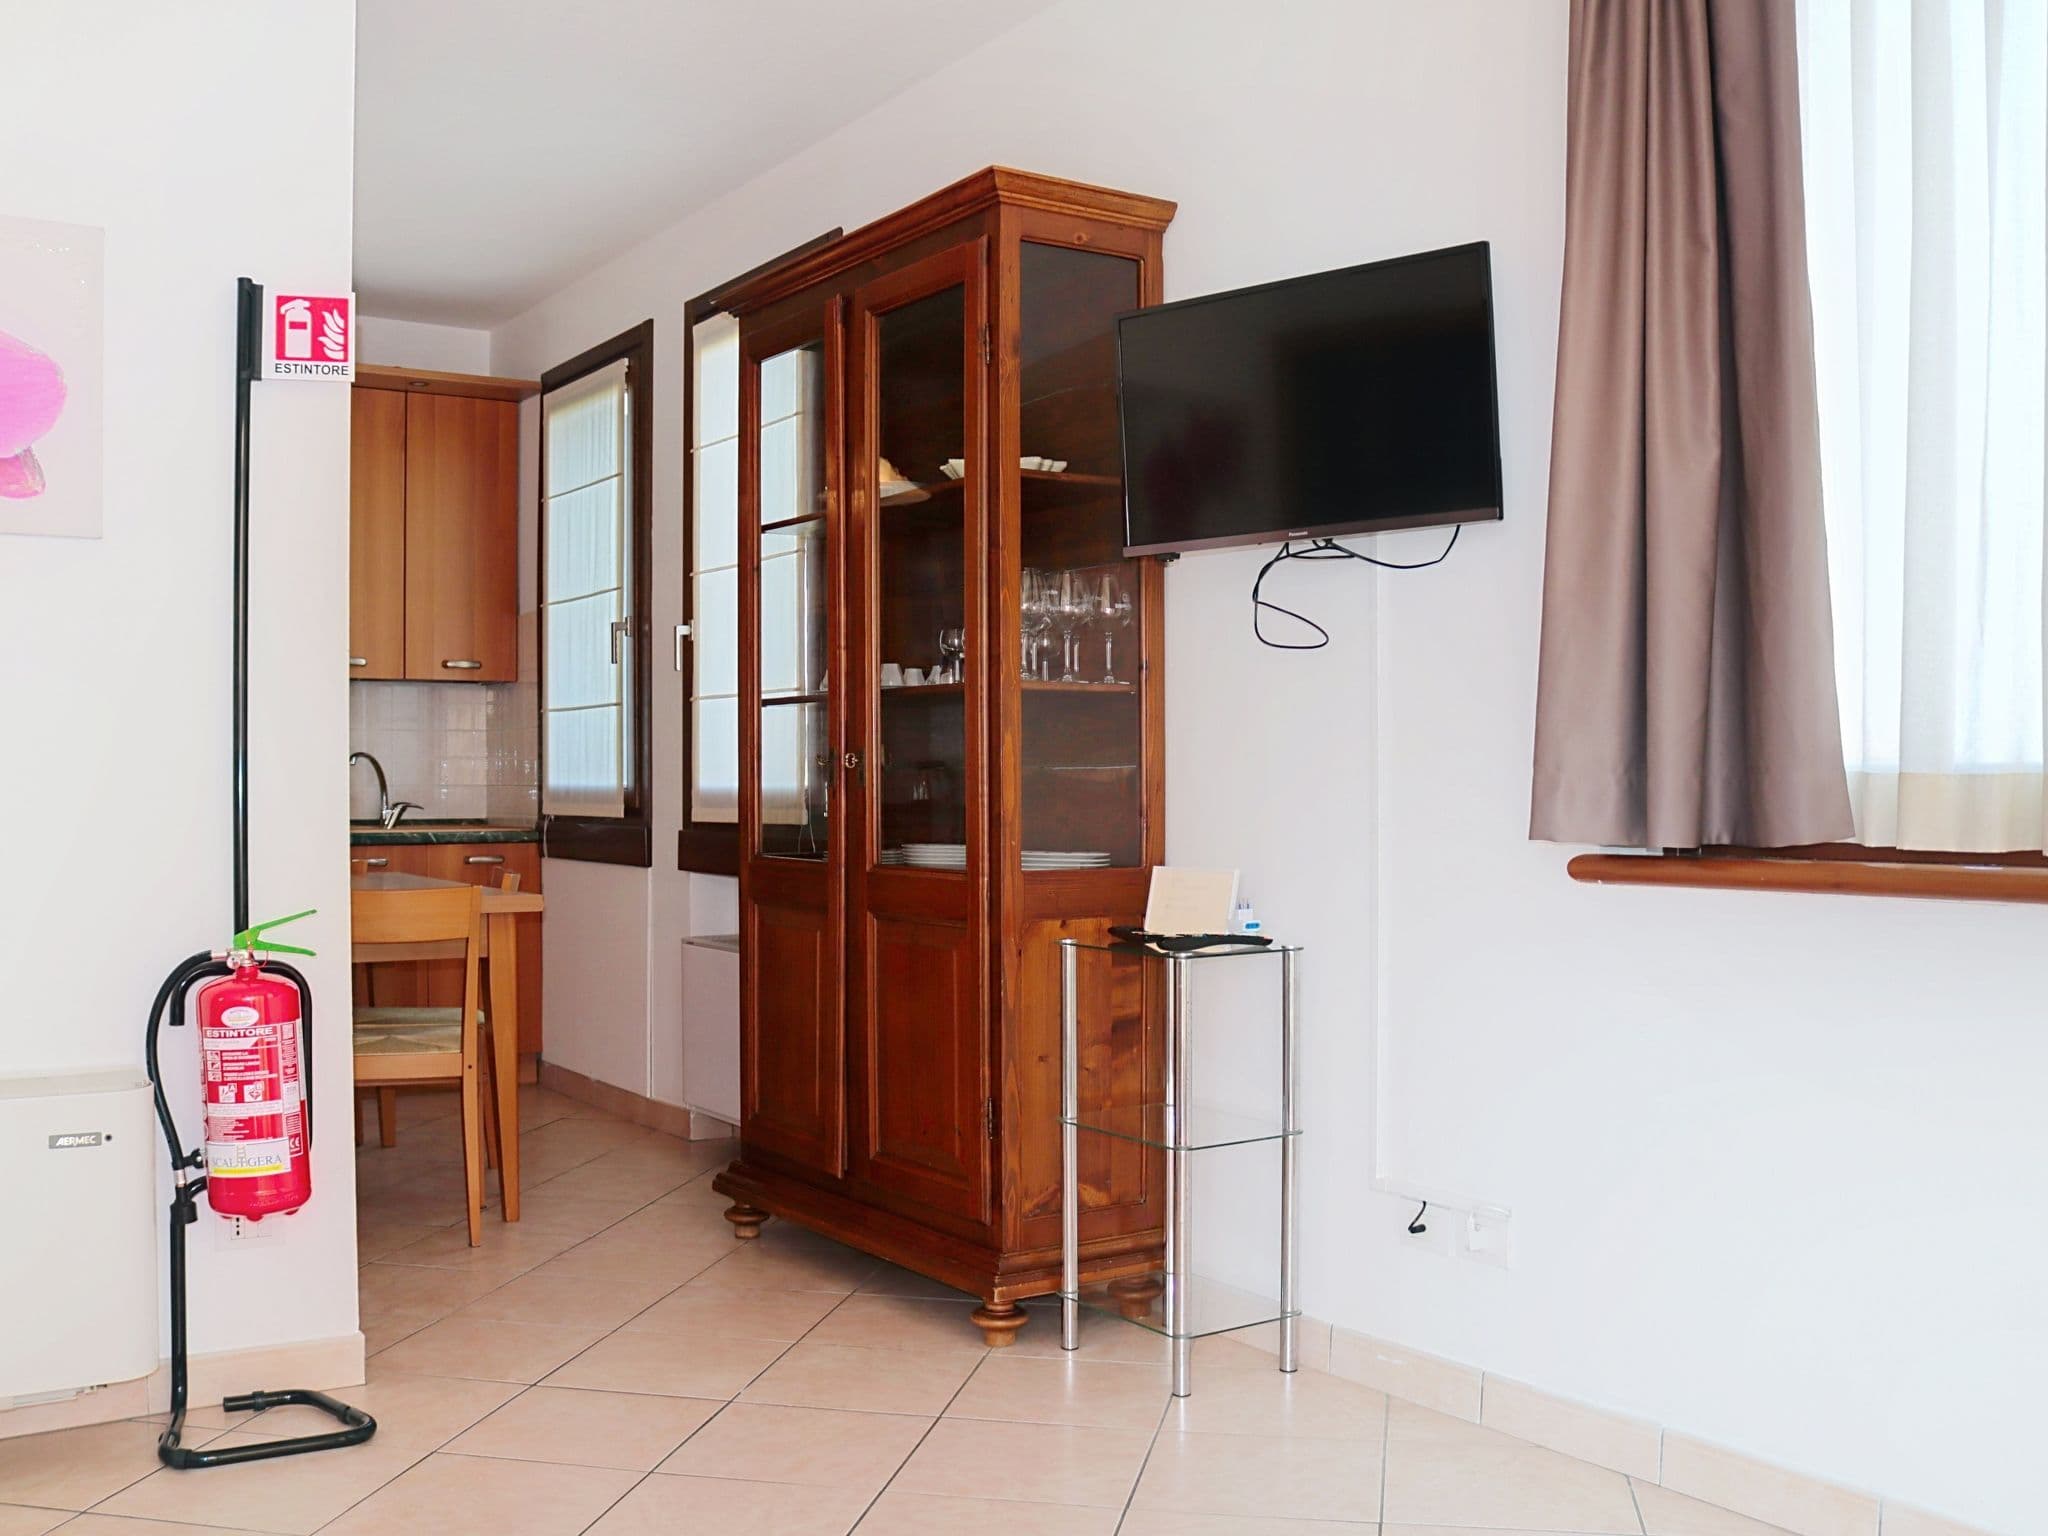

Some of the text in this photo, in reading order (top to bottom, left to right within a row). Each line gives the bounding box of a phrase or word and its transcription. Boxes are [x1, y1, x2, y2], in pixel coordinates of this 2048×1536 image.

[274, 363, 349, 375] ESTINTORE
[206, 1027, 273, 1038] ESTINTORE
[55, 1135, 97, 1147] AERMEC
